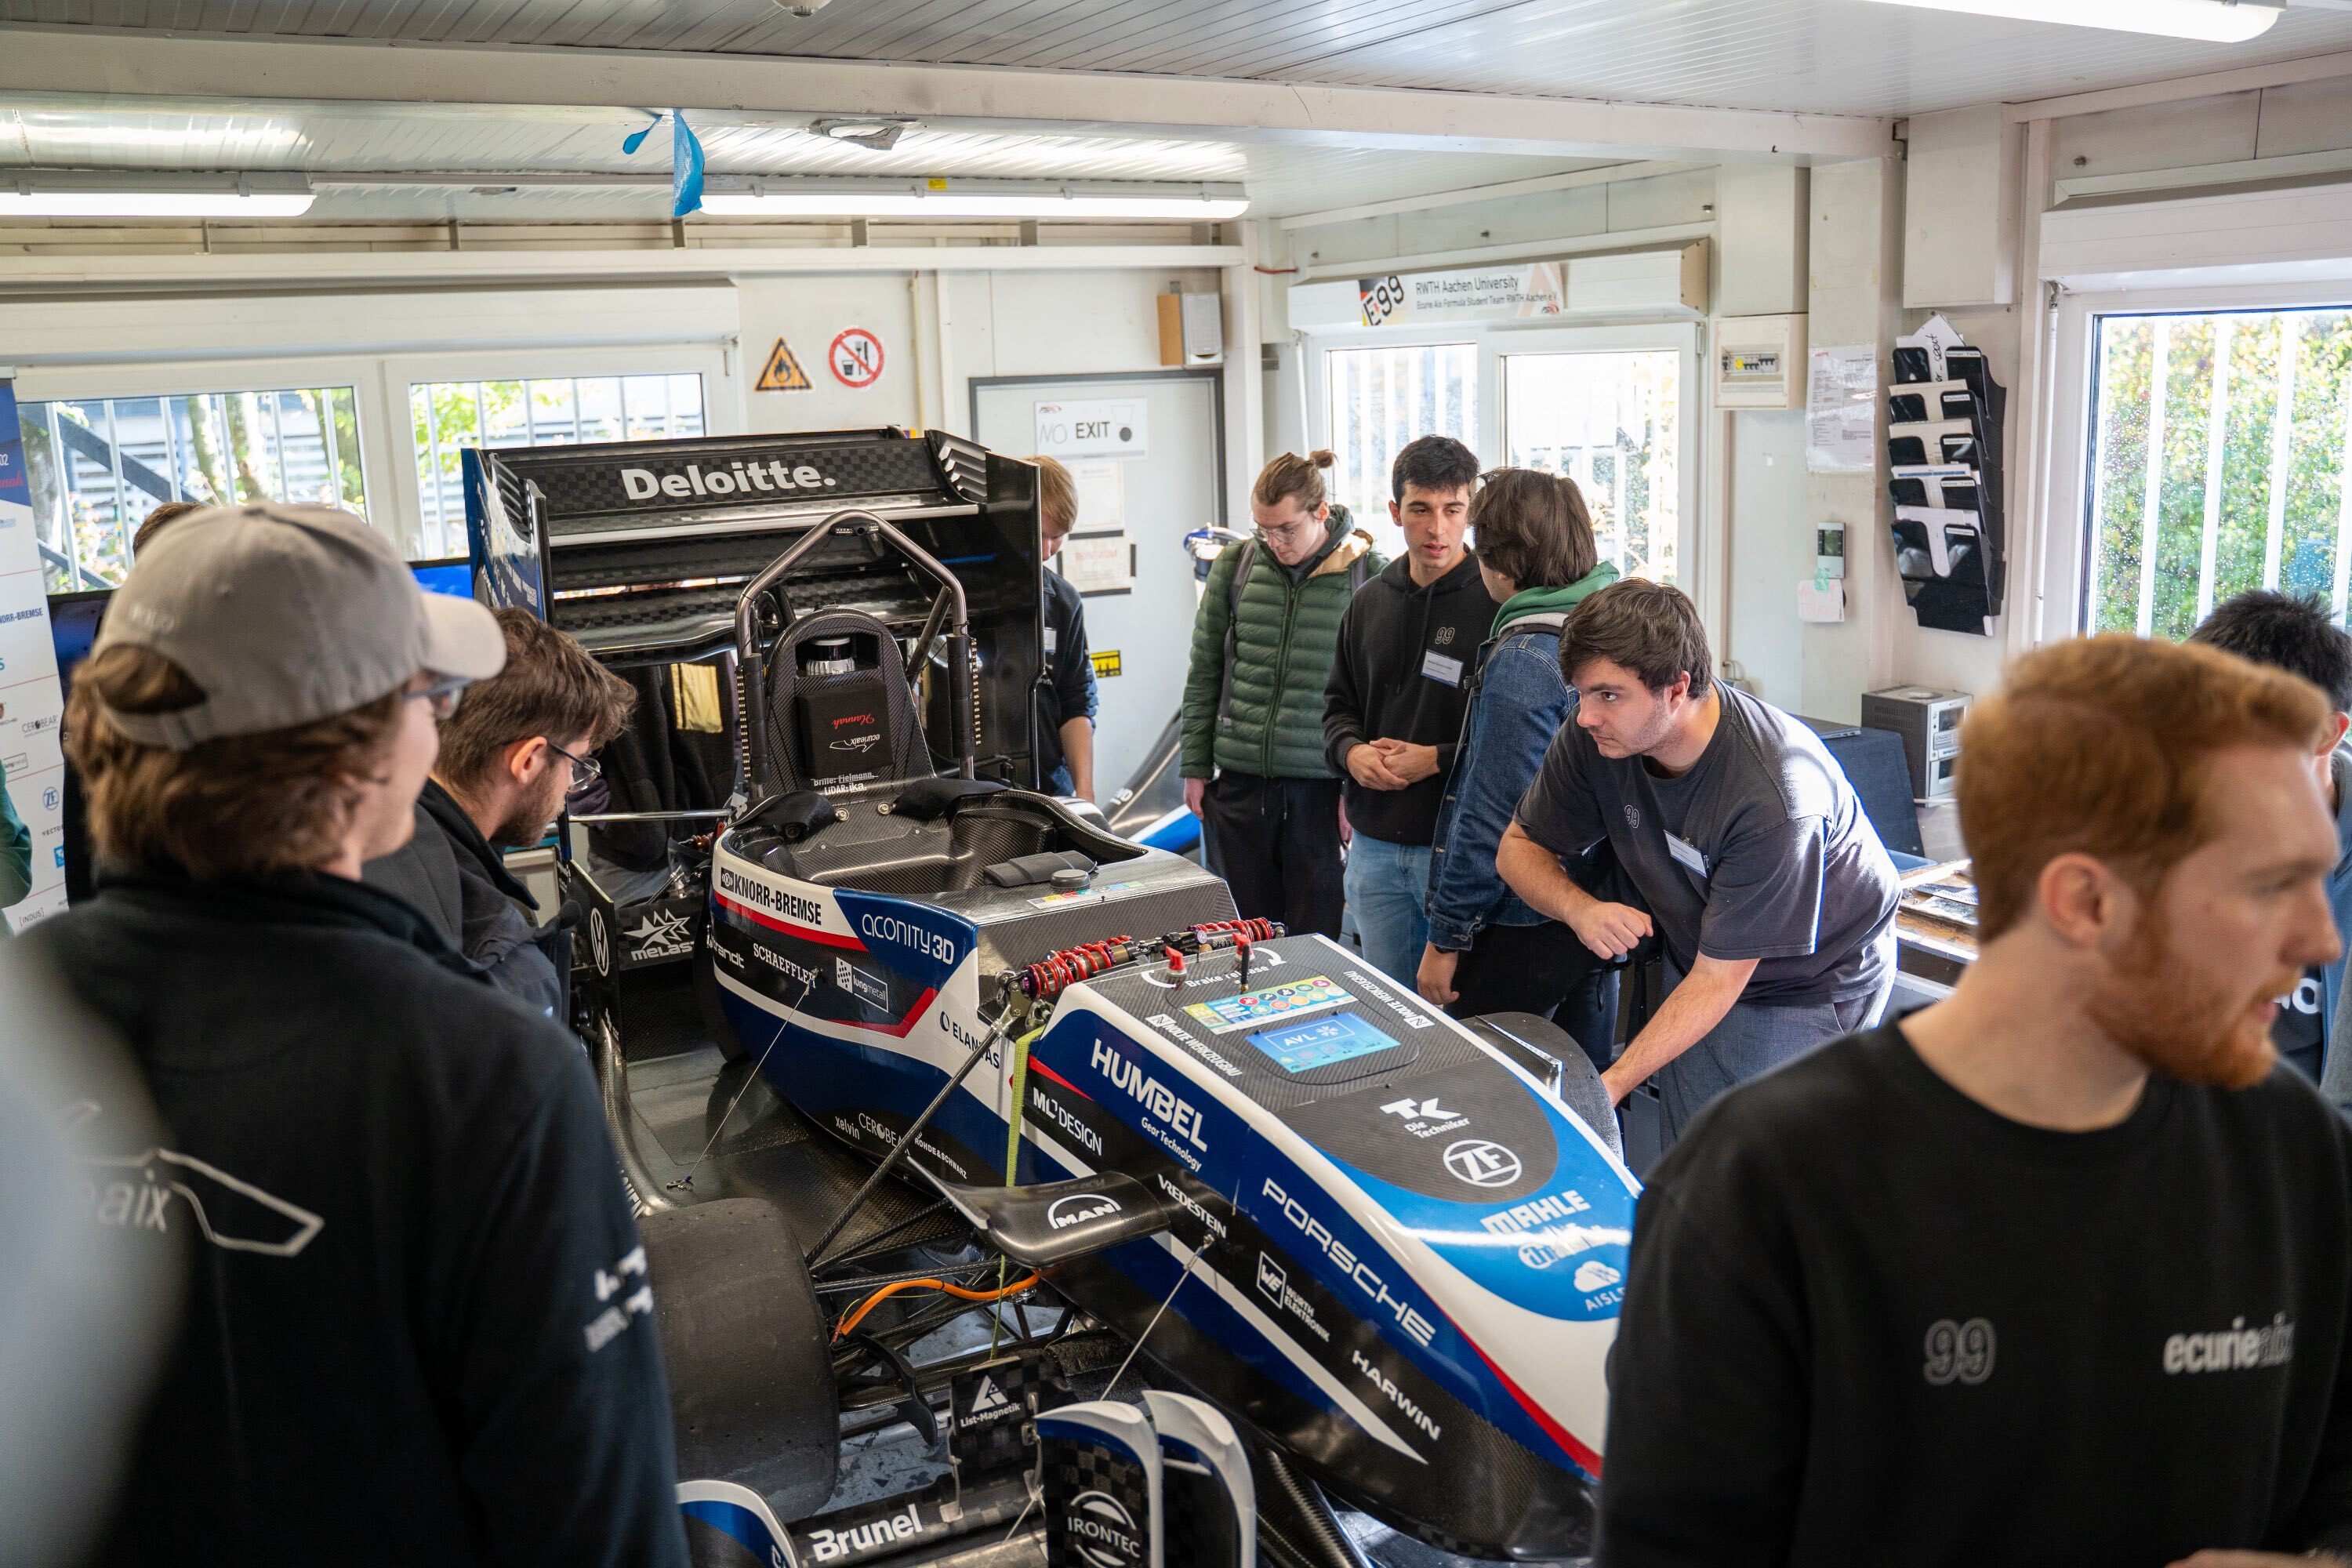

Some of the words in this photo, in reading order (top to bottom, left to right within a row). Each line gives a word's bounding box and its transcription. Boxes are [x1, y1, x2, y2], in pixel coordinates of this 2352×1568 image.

[1416, 281, 1440, 296] RWTH
[1443, 279, 1472, 293] Aachen
[1475, 274, 1519, 293] University
[1444, 298, 1465, 308] Formula
[1467, 296, 1488, 307] Student
[1490, 295, 1505, 304] Team
[1506, 293, 1524, 303] RWTH
[1526, 292, 1547, 302] Aachen
[1039, 423, 1068, 445] NO
[1076, 421, 1110, 440] EXIT
[621, 459, 837, 501] Deloitte.
[1435, 626, 1455, 644] 99
[833, 713, 875, 730] Hannah
[848, 782, 867, 793] ika.
[1624, 804, 1640, 829] 99
[734, 876, 822, 926] KNORR-BREMSE
[852, 974, 886, 1000] lungmetall
[1185, 975, 1223, 988] Brake
[1225, 965, 1269, 979] relase
[953, 1021, 1000, 1069] ELANAS
[1283, 1033, 1318, 1047] AVL
[1091, 1038, 1208, 1152] HUMBEL
[835, 1116, 860, 1141] xelvin
[1058, 1105, 1102, 1156] DESIGN
[1404, 1120, 1426, 1132] Die
[1414, 1117, 1471, 1138] Techniker
[1141, 1116, 1160, 1137] Gear
[1160, 1130, 1202, 1172] Technology
[1446, 1142, 1520, 1185] ZF
[1054, 1203, 1116, 1228] MAN
[1158, 1174, 1227, 1240] VREDESTEIN
[1479, 1189, 1592, 1237] MAHLE
[1261, 1178, 1436, 1347] PORSCHE
[1261, 1264, 1283, 1293] WE
[1284, 1294, 1330, 1342] ELEKTRONIK
[1923, 1316, 1998, 1386] 99
[1352, 1350, 1441, 1440] HARWIN
[960, 1402, 1021, 1428] List-Magnetik
[808, 1504, 923, 1562] Brunel
[1068, 1516, 1141, 1559] IRONTEC
